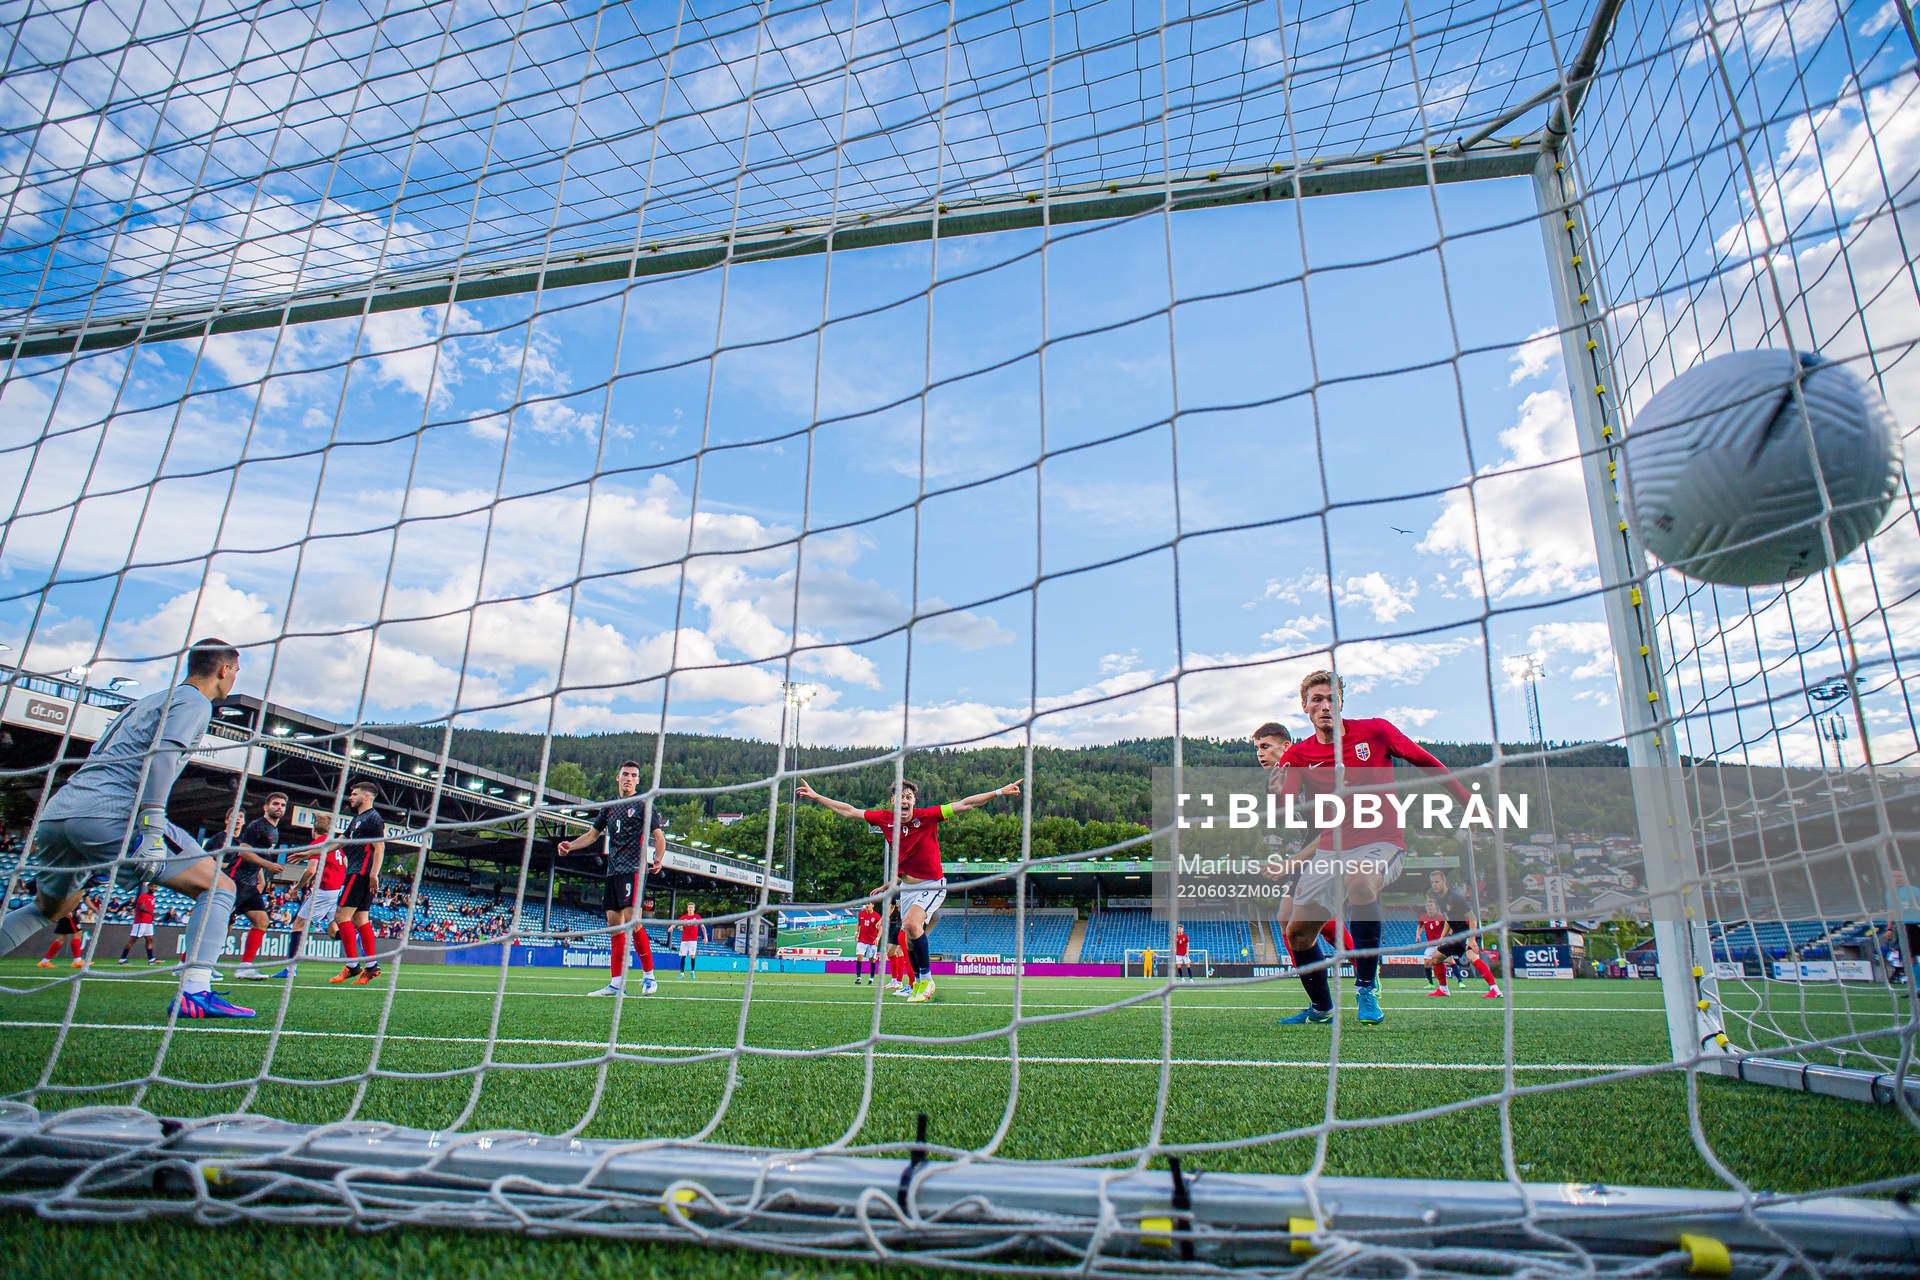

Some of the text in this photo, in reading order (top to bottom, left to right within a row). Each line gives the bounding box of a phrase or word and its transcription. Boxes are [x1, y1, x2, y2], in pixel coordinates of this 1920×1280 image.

[902, 826, 909, 836] 9
[424, 867, 470, 881] NORGIPS
[625, 883, 631, 897] 9
[563, 949, 588, 967] Equinor
[1524, 946, 1559, 963] ecit
